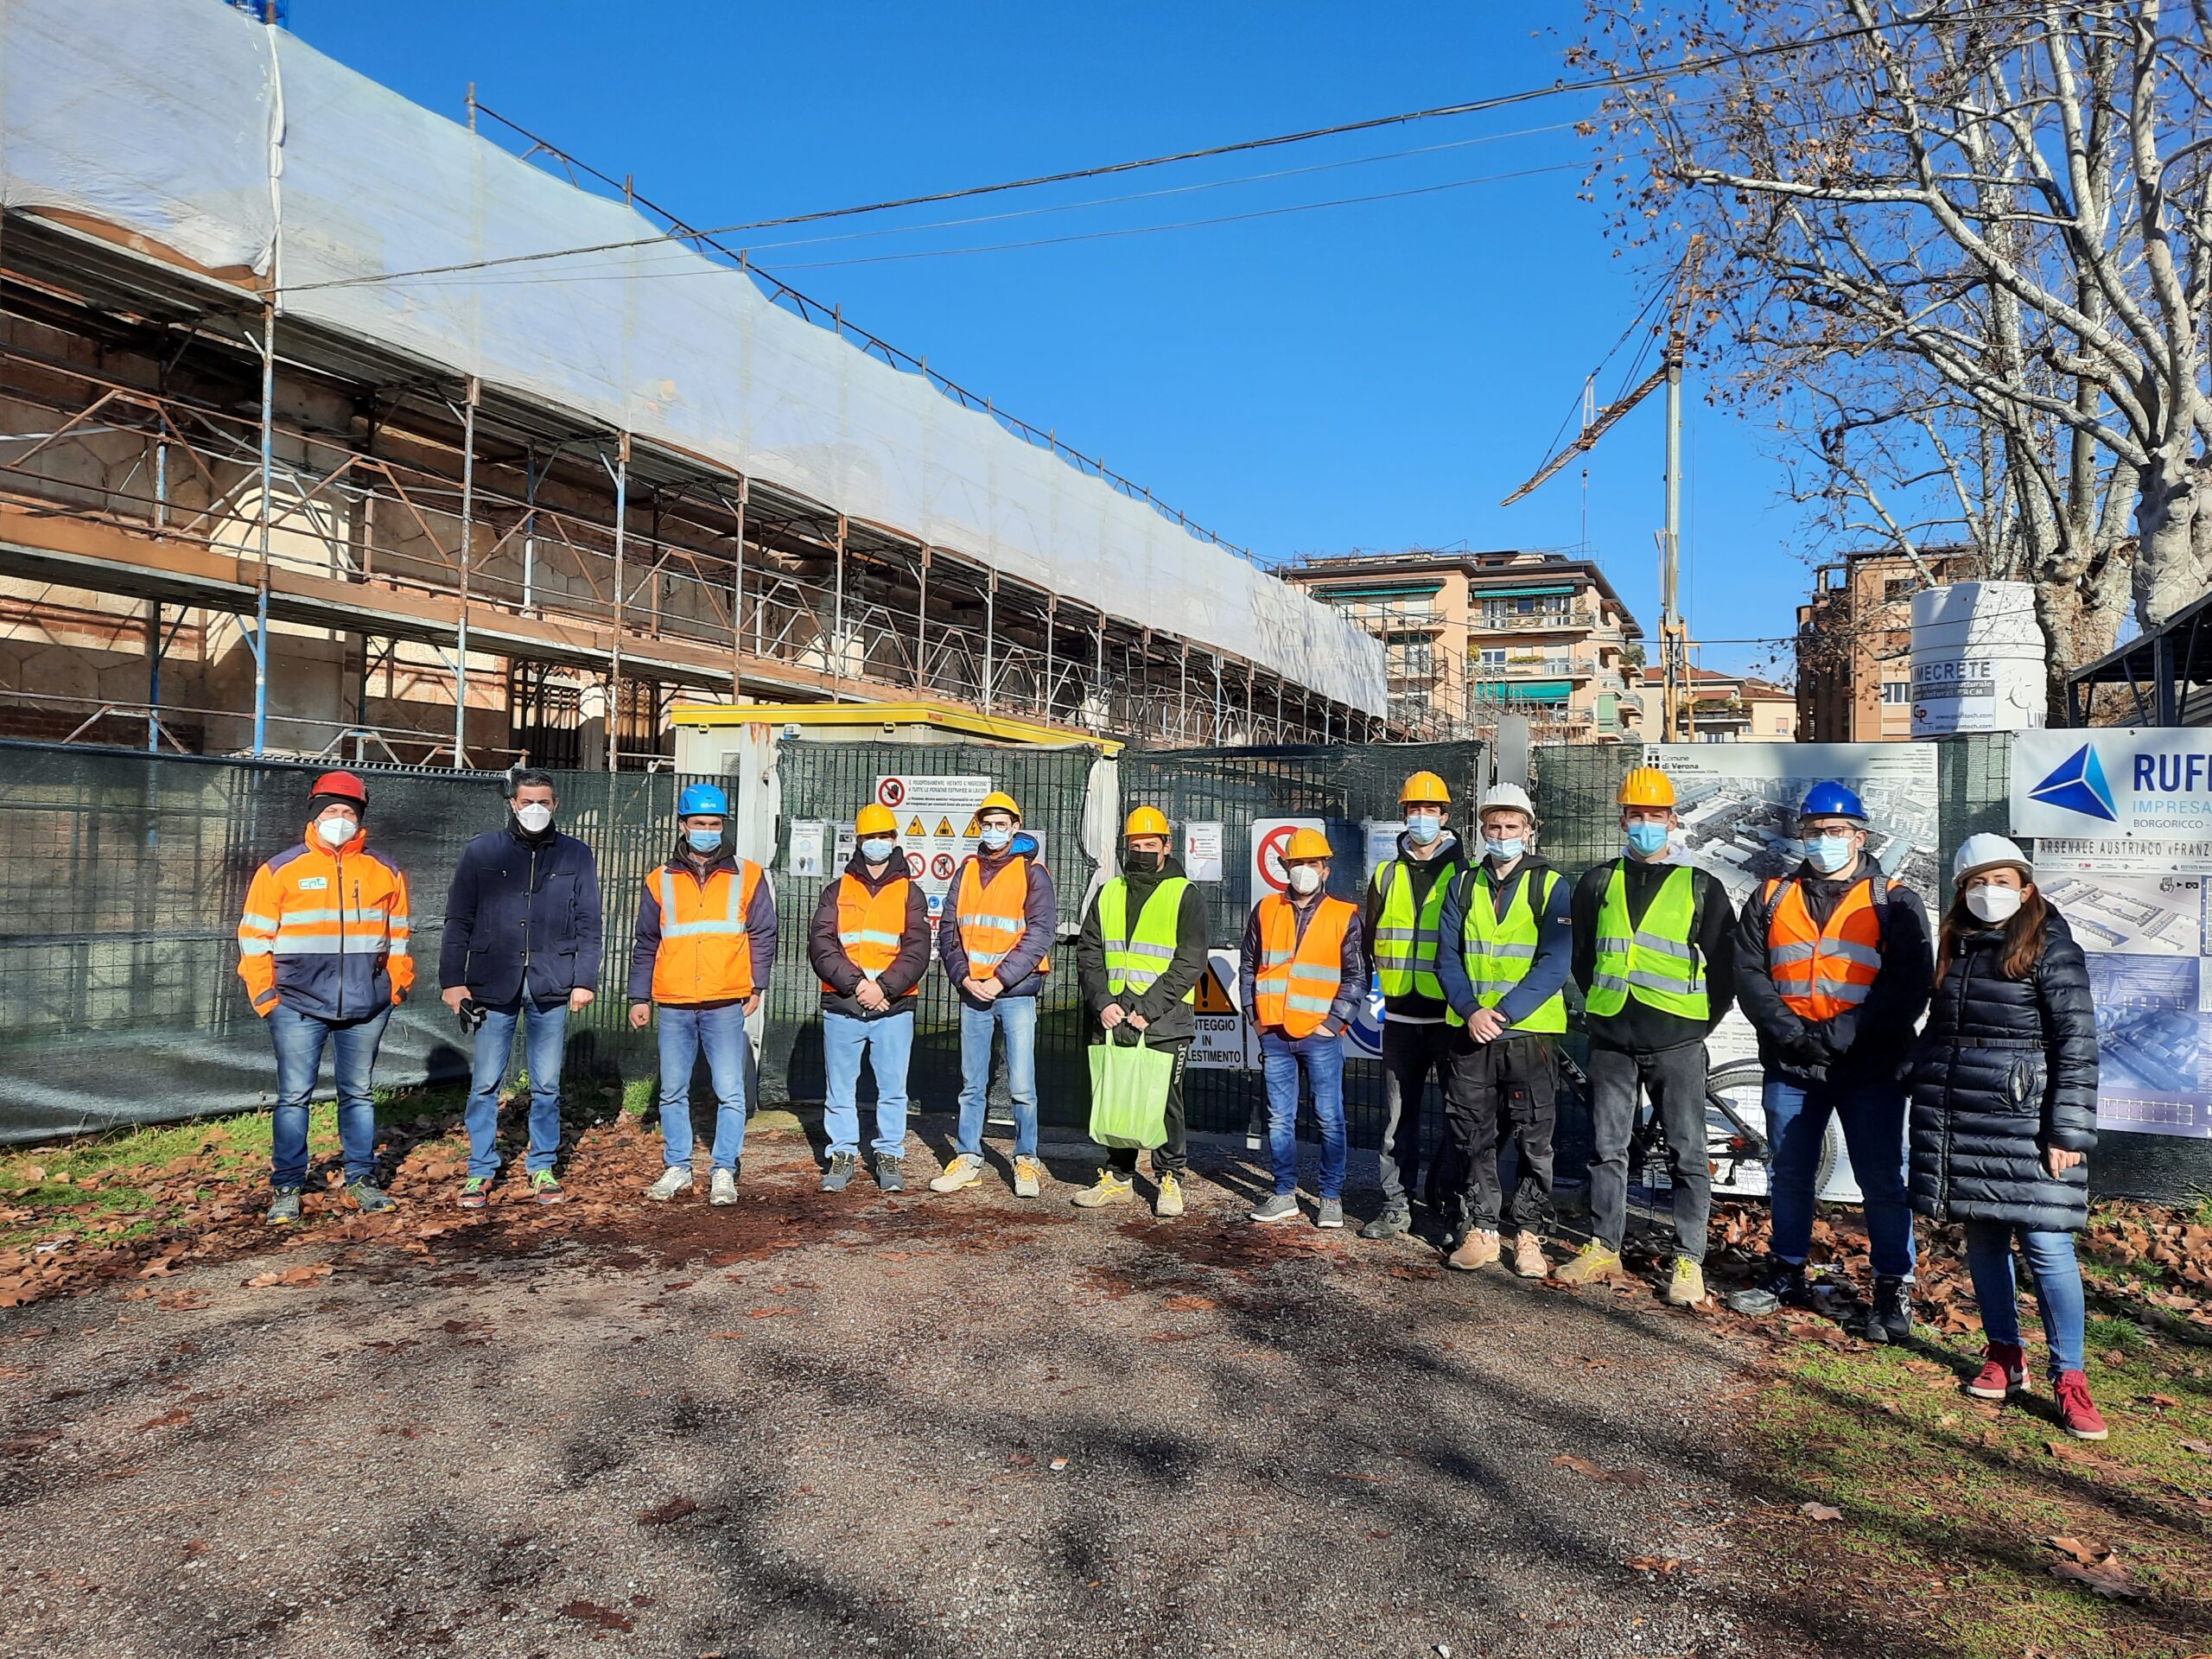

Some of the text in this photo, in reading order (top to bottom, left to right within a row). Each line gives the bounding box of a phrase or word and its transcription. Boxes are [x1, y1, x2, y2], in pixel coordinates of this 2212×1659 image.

[2133, 753, 2212, 791] RUF
[2133, 800, 2212, 814] IMPRESA
[2133, 819, 2203, 829] BORGORICCO
[2040, 841, 2094, 855] ARSENALE
[2100, 842, 2161, 855] AUSTRIACO
[1202, 1034, 1211, 1046] IN
